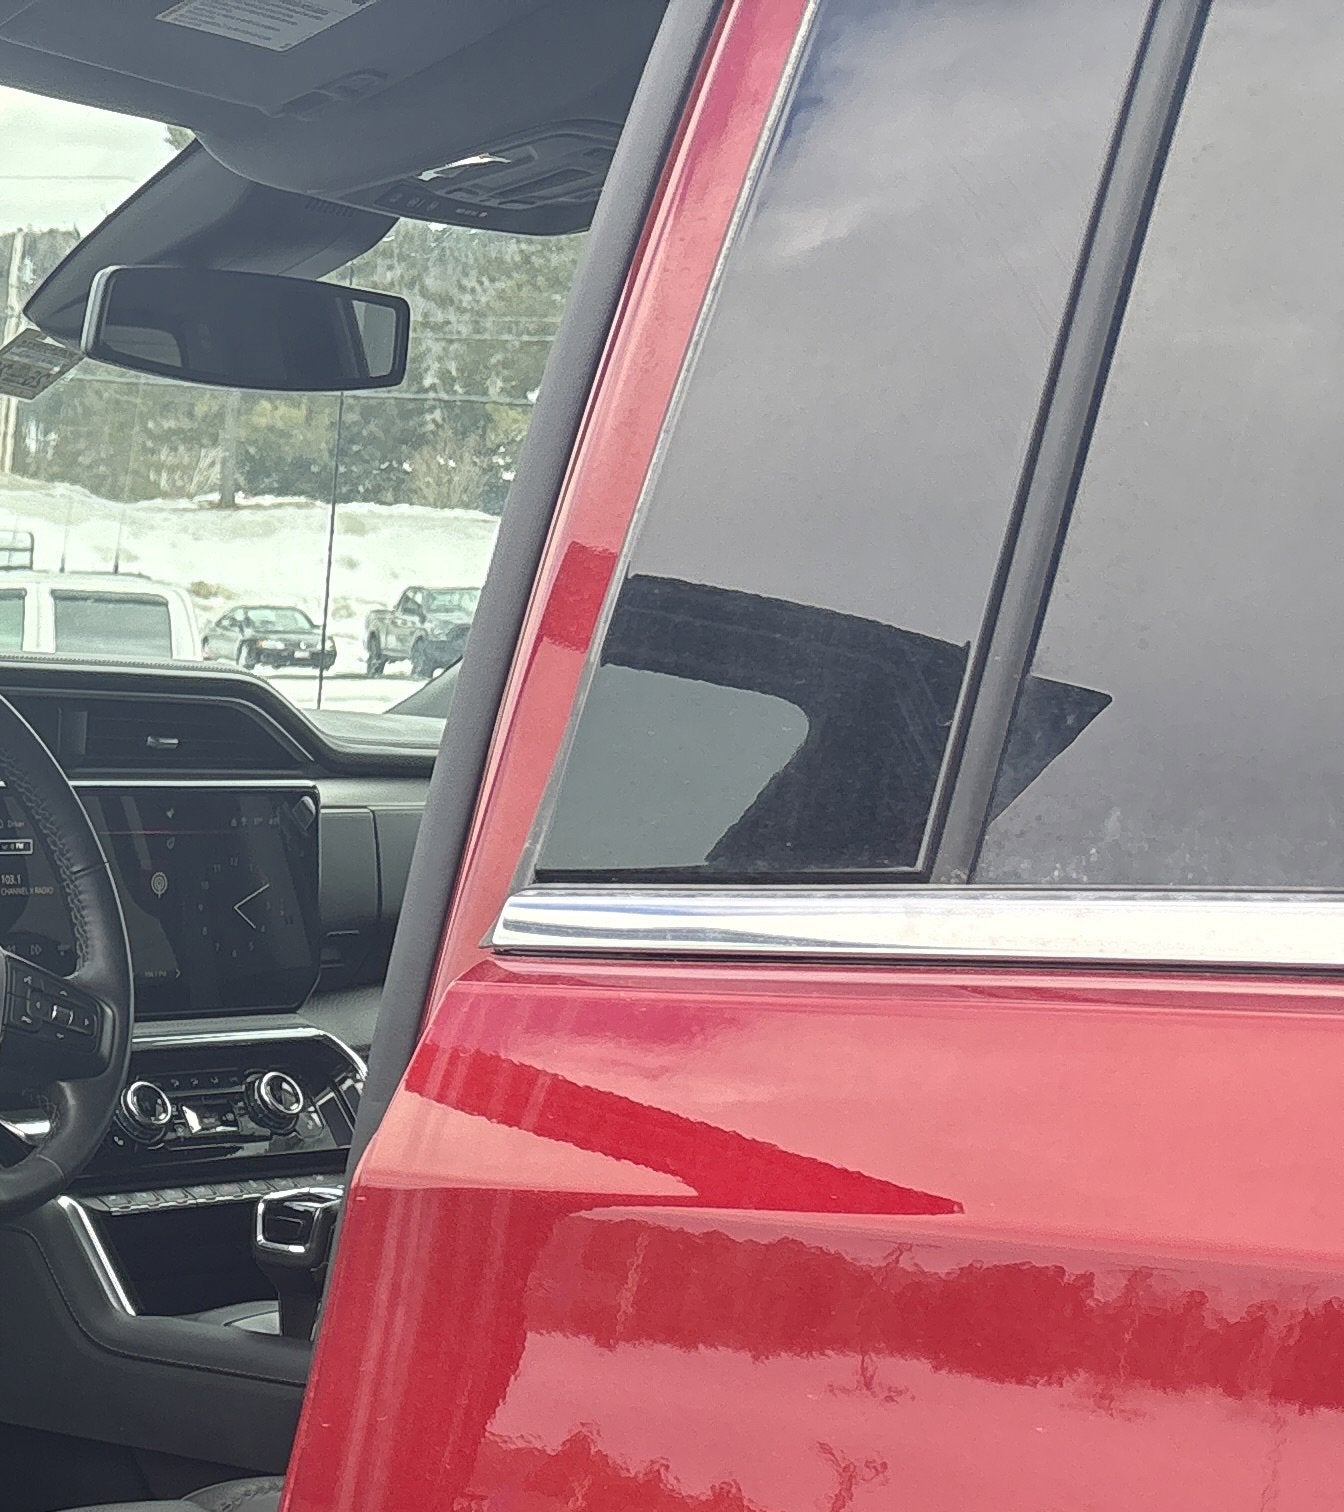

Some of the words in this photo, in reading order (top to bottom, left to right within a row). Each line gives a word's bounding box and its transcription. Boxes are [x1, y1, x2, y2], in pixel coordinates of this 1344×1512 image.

[1, 874, 21, 885] 103.1
[0, 887, 30, 897] CHANNEL
[34, 886, 54, 895] RADIO
